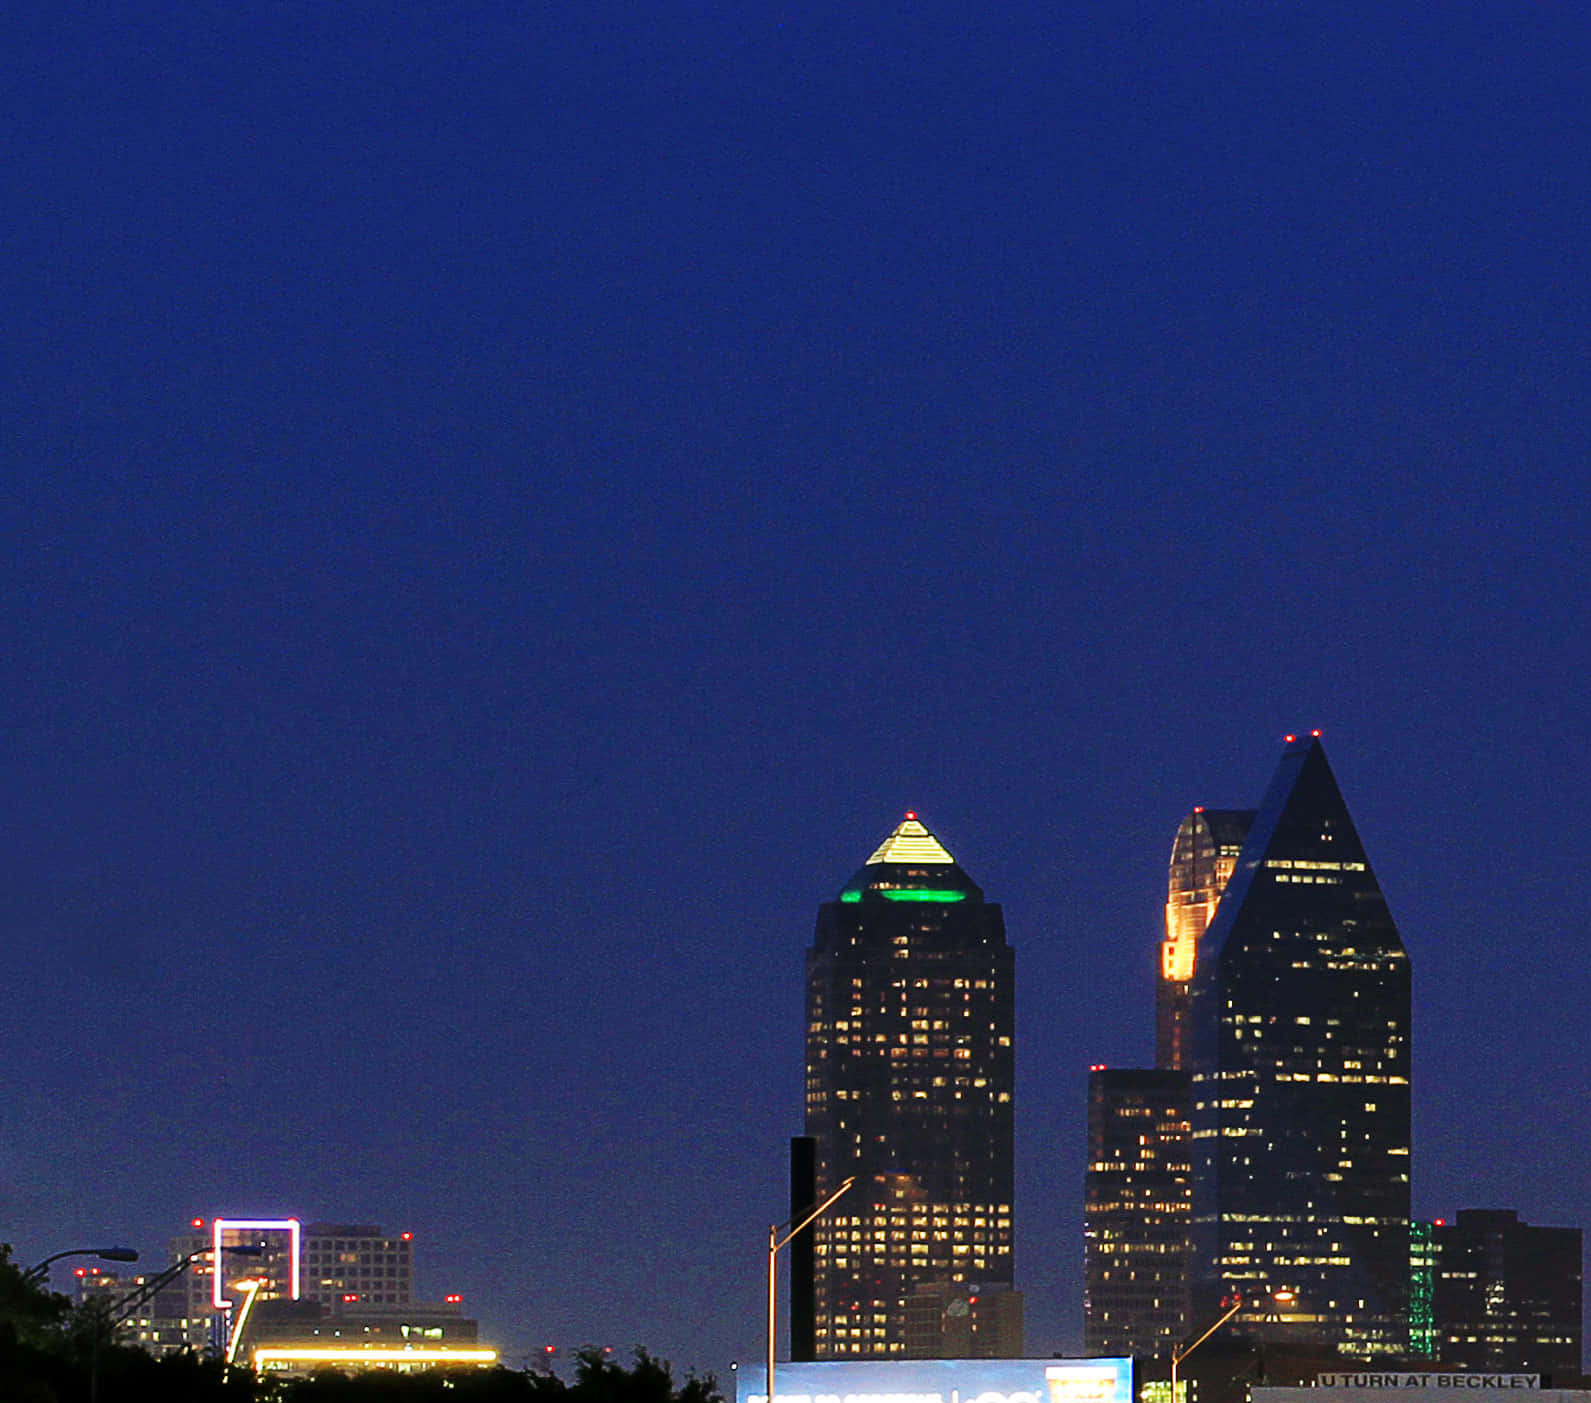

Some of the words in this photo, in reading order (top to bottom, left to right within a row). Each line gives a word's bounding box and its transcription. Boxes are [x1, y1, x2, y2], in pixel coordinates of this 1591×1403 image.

[1320, 1375, 1337, 1389] U
[1340, 1375, 1400, 1389] TURN
[1404, 1375, 1431, 1389] AT
[1437, 1375, 1538, 1389] BECKLEY
